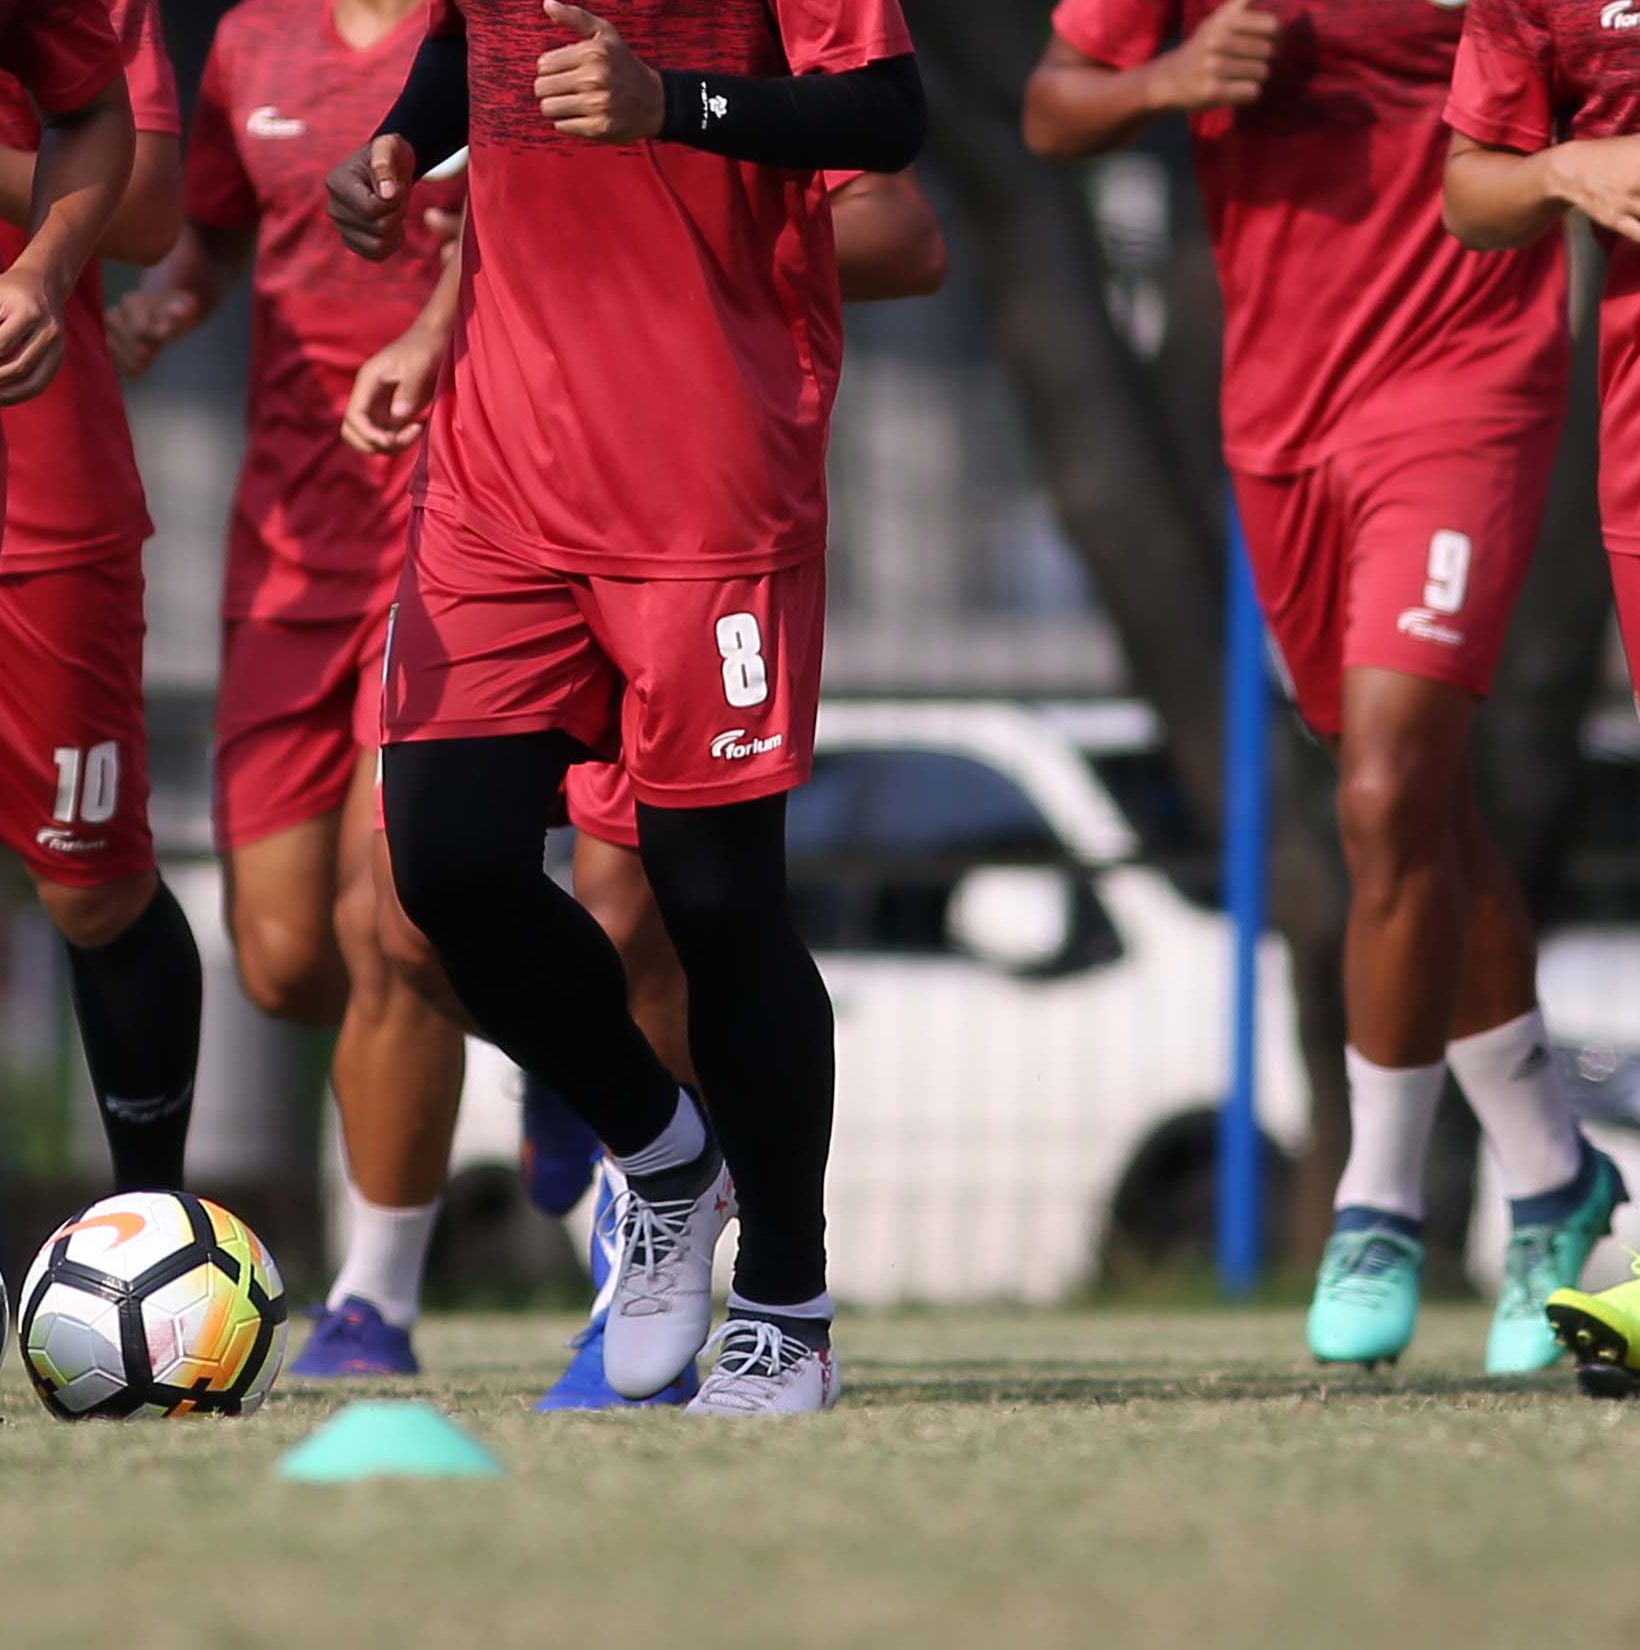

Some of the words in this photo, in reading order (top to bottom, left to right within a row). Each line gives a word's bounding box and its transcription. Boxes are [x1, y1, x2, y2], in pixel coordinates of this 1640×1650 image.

[1423, 529, 1472, 614] 9
[716, 612, 768, 708] 8
[53, 741, 118, 823] 10
